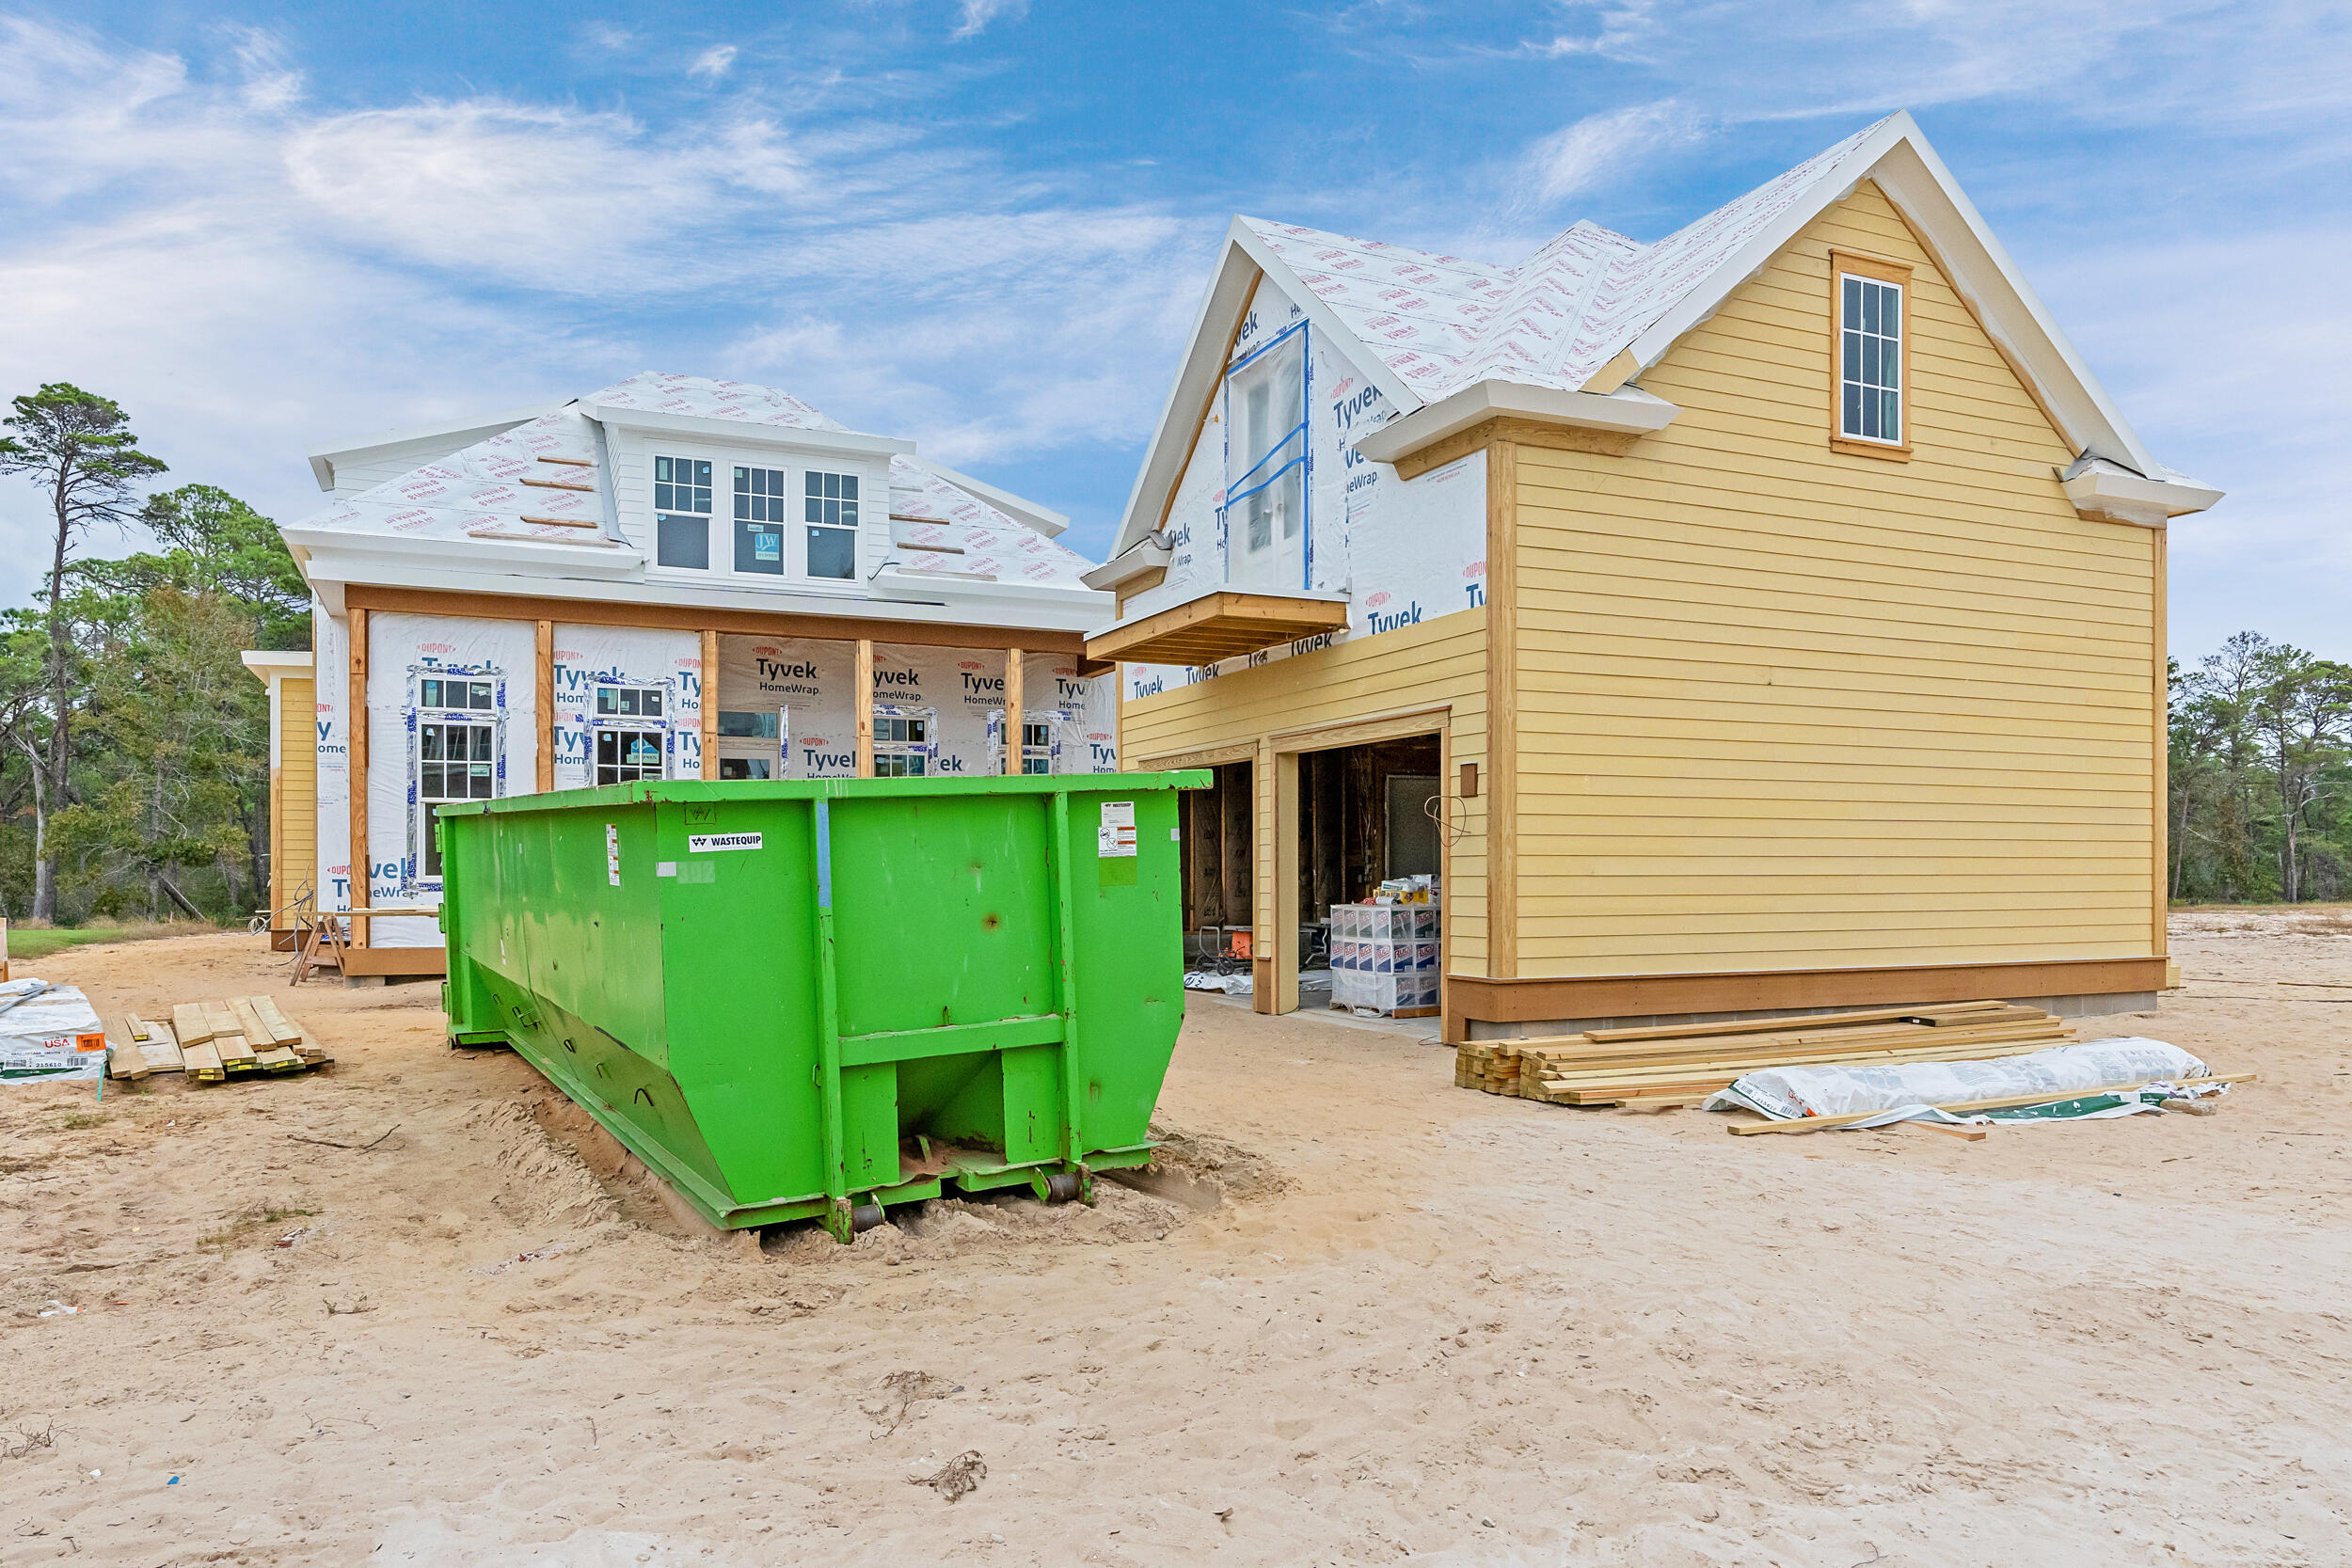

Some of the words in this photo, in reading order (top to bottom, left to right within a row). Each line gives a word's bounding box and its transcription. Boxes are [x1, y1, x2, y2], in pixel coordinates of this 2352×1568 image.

[1368, 592, 1388, 607] DUPONT
[1368, 600, 1422, 635] Tyvek
[421, 643, 452, 653] DUPONT
[756, 647, 779, 656] DUPONT
[756, 658, 817, 681] Tyvek
[961, 662, 982, 671] DUPONT
[873, 669, 918, 688] yvek
[961, 673, 1004, 693] Tyve
[759, 682, 819, 696] HomeWrap
[873, 690, 921, 702] omeWrap
[803, 737, 826, 746] DUPONT
[1089, 733, 1110, 741] DUPONT
[318, 745, 346, 753] ome
[711, 835, 761, 847] WASTEQUIP
[44, 1038, 70, 1048] USA
